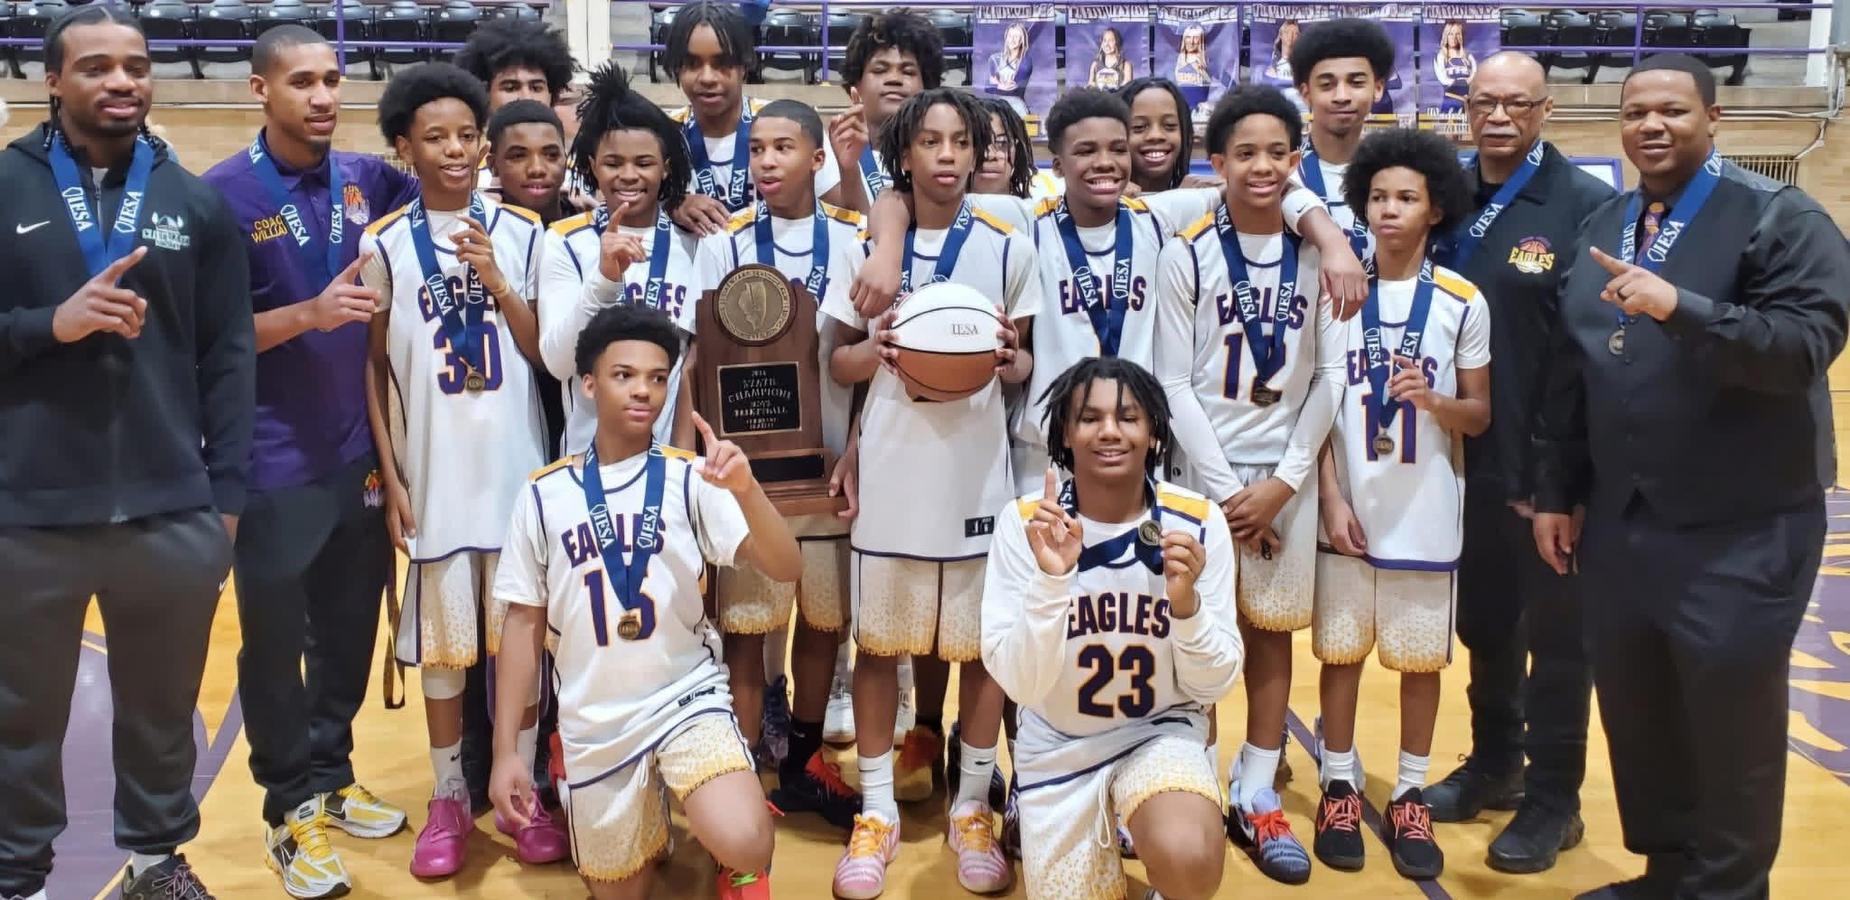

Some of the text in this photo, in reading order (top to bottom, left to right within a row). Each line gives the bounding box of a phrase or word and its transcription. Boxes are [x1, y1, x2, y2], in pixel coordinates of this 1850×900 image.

[66, 197, 95, 232] IESA
[118, 191, 144, 225] IESA
[331, 203, 344, 236] IESA
[1478, 203, 1504, 232] IESA
[285, 211, 311, 247] IESA
[1657, 220, 1685, 252] IESA
[1115, 258, 1130, 291] IESA
[432, 283, 456, 316] IESA
[1076, 276, 1099, 308] IESA
[1236, 290, 1259, 322] IESA
[1278, 281, 1295, 314] IESA
[951, 323, 980, 336] IESA
[433, 319, 504, 396] 30
[598, 517, 616, 549] IESA
[641, 505, 661, 537] IESA
[1066, 591, 1172, 641] EAGLES
[1075, 643, 1157, 719] 23
